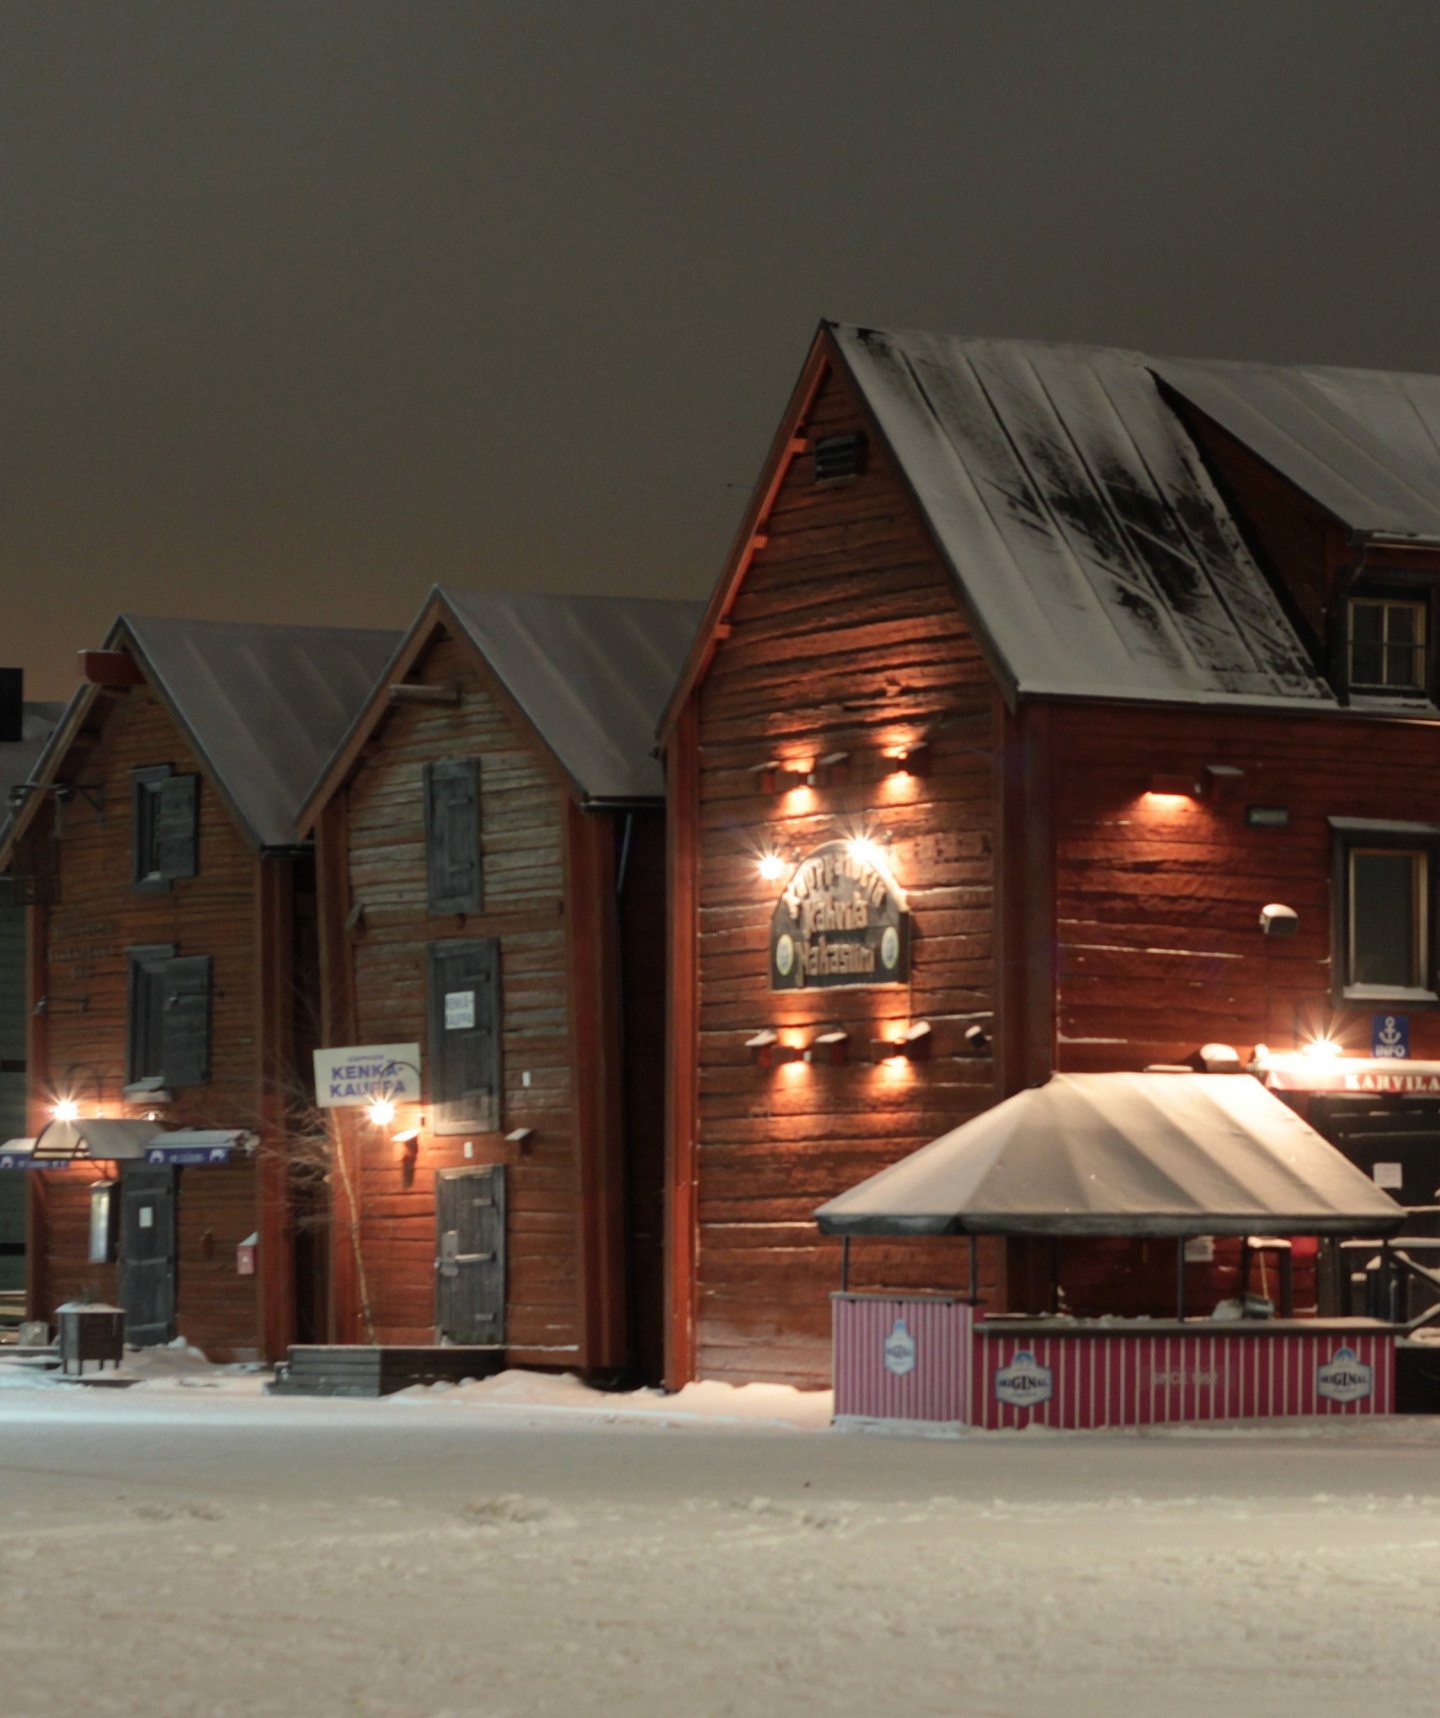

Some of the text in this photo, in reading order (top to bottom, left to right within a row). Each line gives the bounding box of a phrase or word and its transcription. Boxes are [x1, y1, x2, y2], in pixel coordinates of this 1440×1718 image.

[1375, 1044, 1406, 1058] INFO
[331, 1059, 403, 1081] KENKÄ-
[329, 1080, 405, 1098] KAUPPA
[1345, 1073, 1440, 1091] KAHVILA
